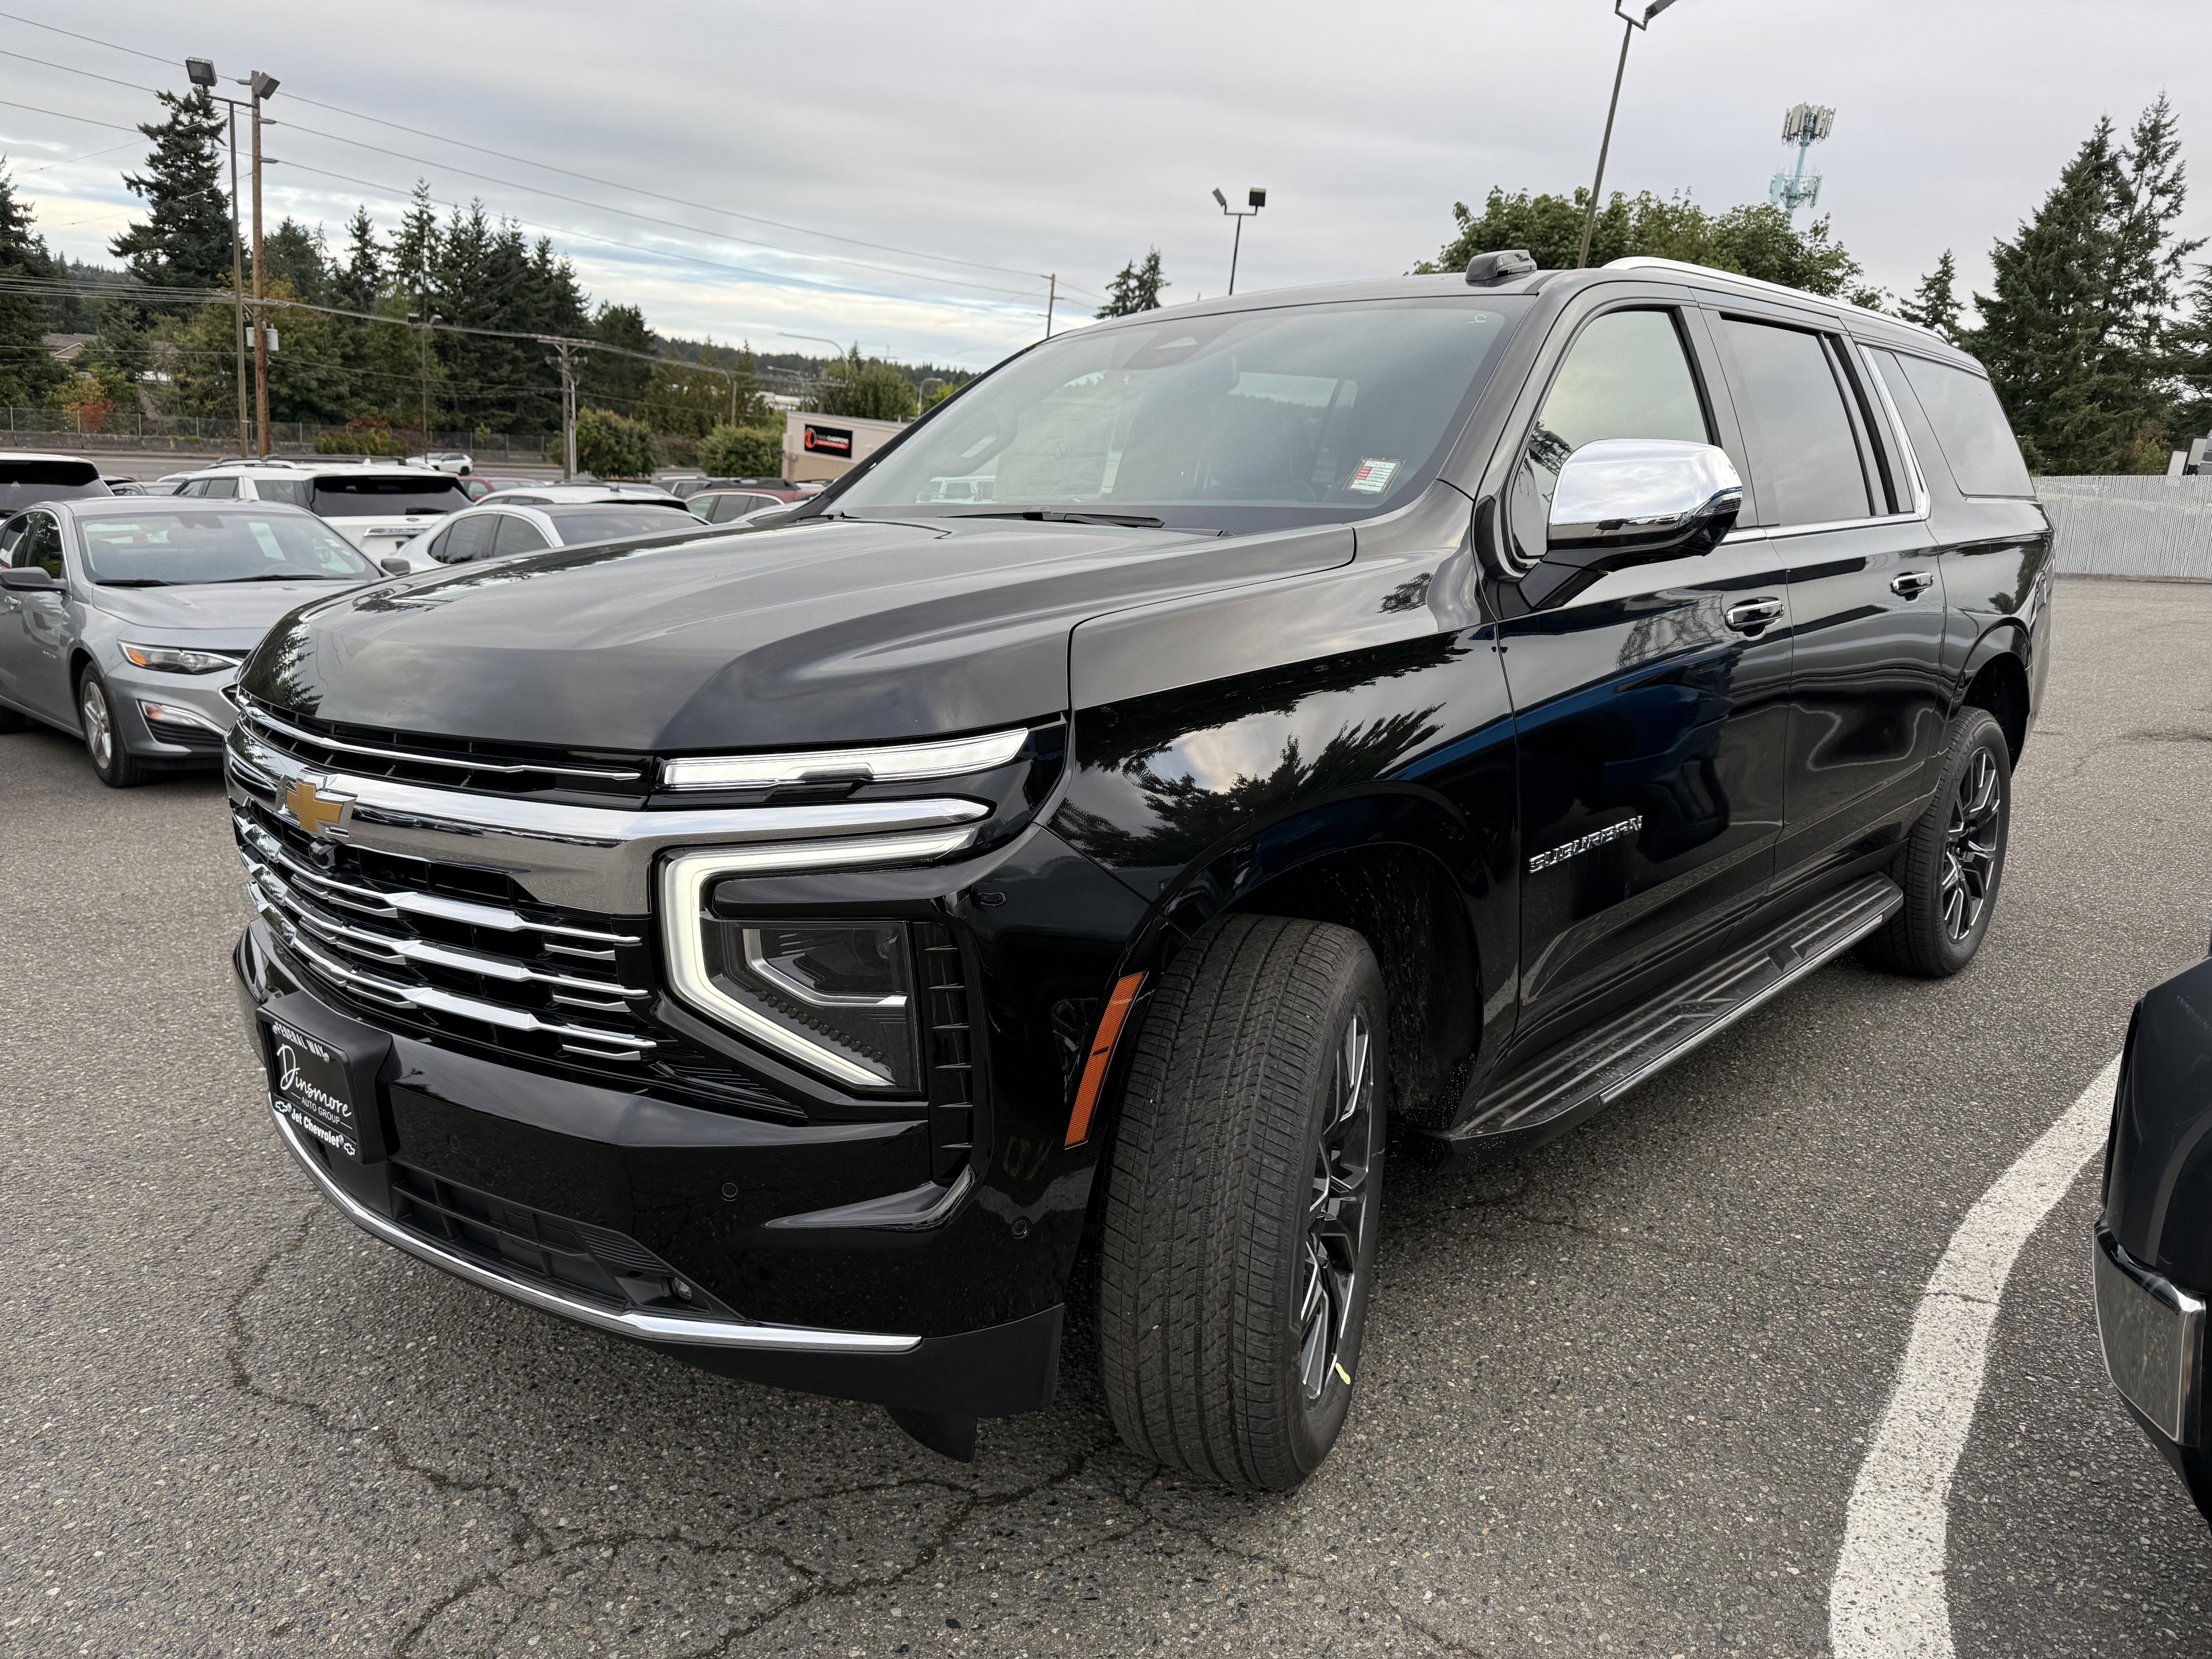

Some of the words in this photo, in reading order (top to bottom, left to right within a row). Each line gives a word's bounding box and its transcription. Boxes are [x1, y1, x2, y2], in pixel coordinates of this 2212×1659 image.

[1529, 815, 1642, 873] SUBURBAN
[275, 1022, 307, 1050] FEDERAL
[306, 1039, 325, 1057] WAY
[276, 1043, 352, 1117] Dinsmore
[291, 1108, 302, 1125] Jet
[303, 1116, 340, 1148] Chevrolet
[301, 1096, 317, 1112] AUTO
[318, 1107, 340, 1124] GROUP
